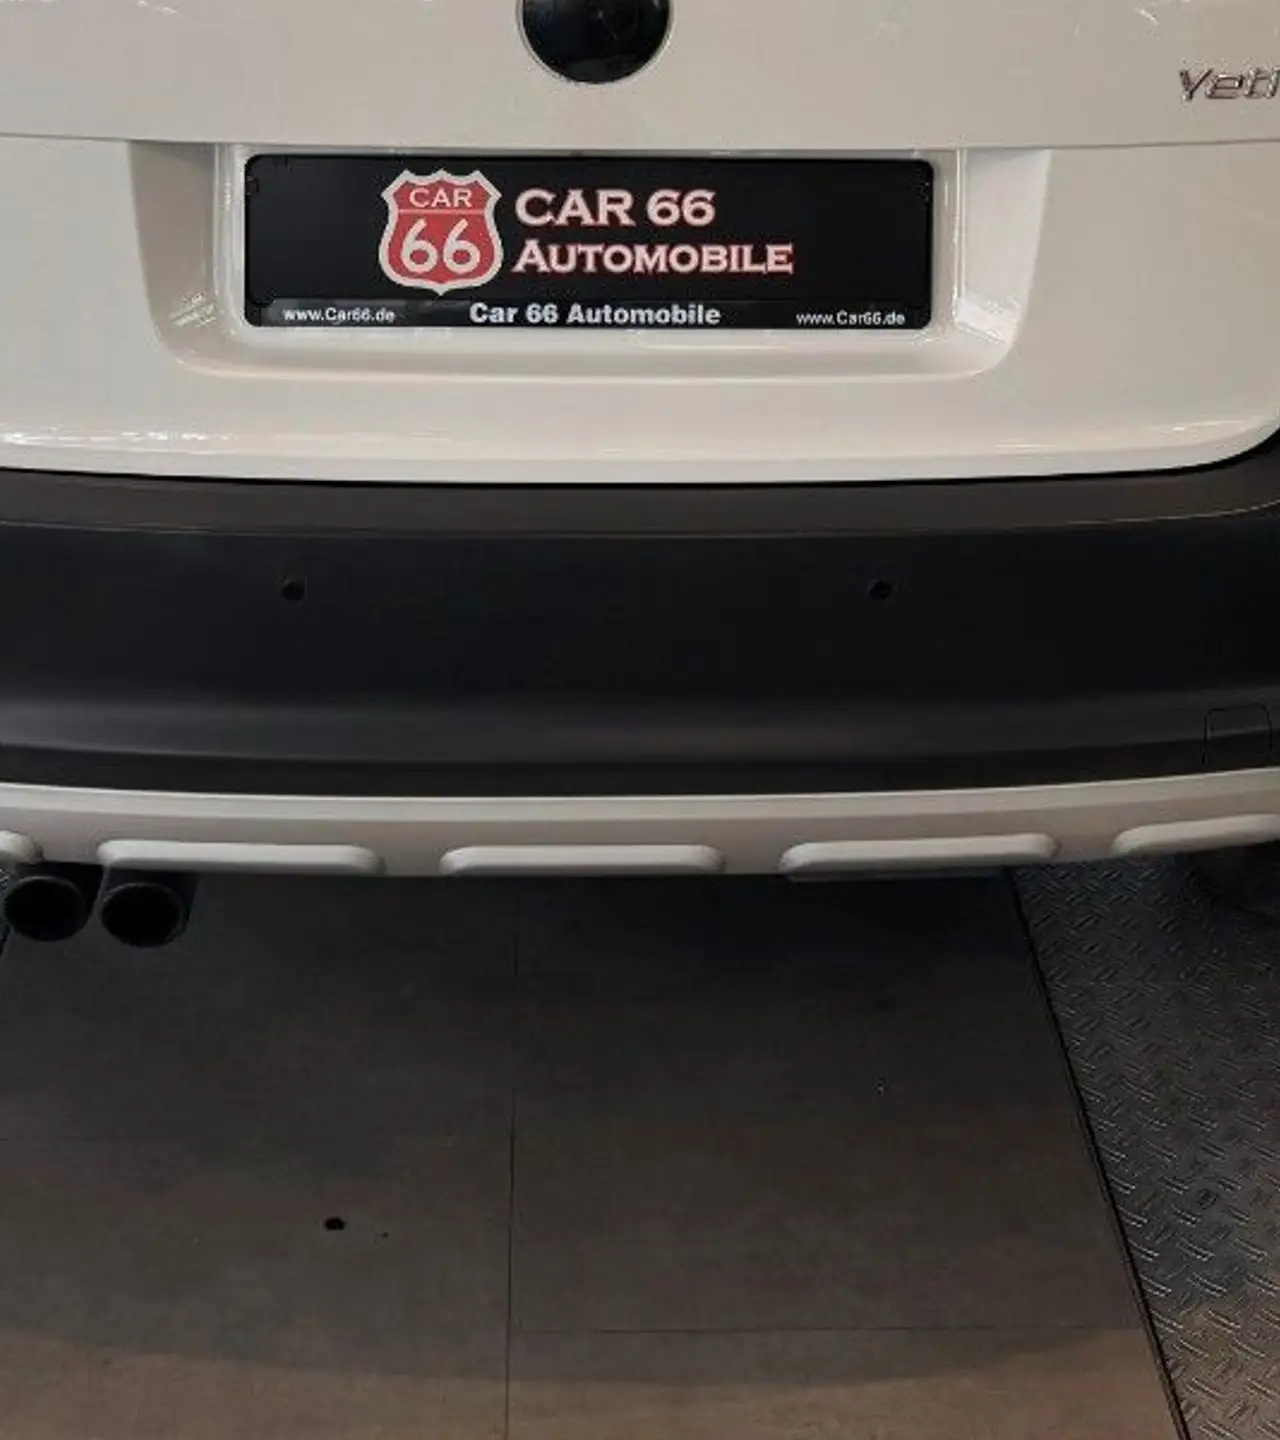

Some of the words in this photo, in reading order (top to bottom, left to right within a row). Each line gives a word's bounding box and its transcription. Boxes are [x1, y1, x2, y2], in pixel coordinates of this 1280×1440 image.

[409, 187, 473, 209] CAR
[515, 189, 637, 227] CAR
[646, 189, 717, 227] 66
[400, 217, 481, 274] 66
[283, 306, 397, 323] www.Car66.de
[469, 301, 518, 325] Car
[526, 302, 560, 325] 66
[566, 301, 721, 326] Automobile
[795, 309, 906, 326] www.Car66.de
